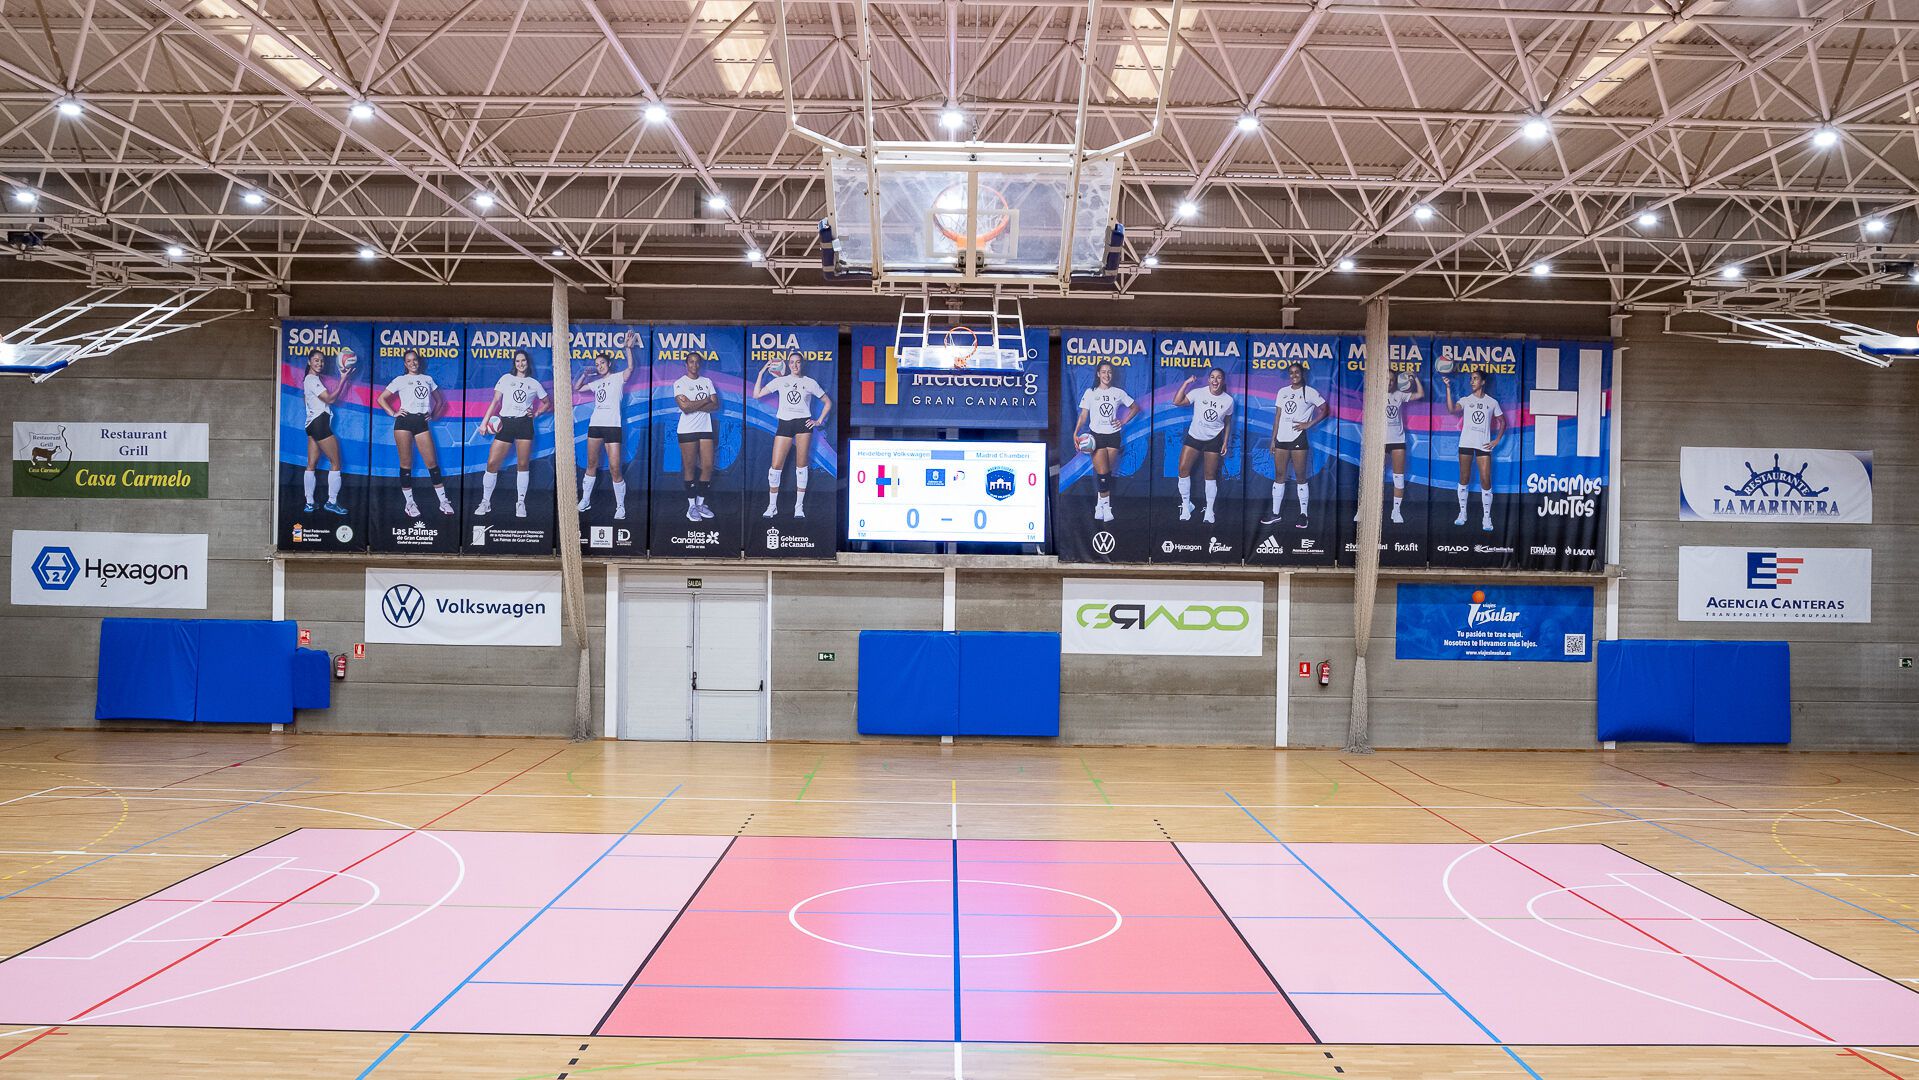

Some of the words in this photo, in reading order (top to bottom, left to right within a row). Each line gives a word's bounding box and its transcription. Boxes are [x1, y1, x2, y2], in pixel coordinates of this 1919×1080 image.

[289, 324, 341, 345] SOFÍA
[380, 329, 460, 347] CANDELA
[658, 333, 706, 349] WIN
[751, 333, 800, 349] LOLA
[1066, 337, 1148, 355] CLAUDIA
[1160, 339, 1240, 357] CAMILA
[1253, 341, 1333, 359] DAYANA
[1348, 343, 1423, 361] MEIA
[569, 349, 625, 360] RANDA
[658, 350, 719, 361] MEDNA
[1442, 345, 1516, 363] BLANCA
[1160, 357, 1212, 368] HIRUELA
[912, 395, 955, 405] GRAN
[965, 396, 1037, 406] CANARIA
[100, 428, 168, 440] Restaurant
[119, 445, 148, 456] Grill
[75, 468, 116, 487] Casa
[121, 469, 191, 487] Carmelo
[857, 470, 866, 484] 0
[1028, 472, 1037, 487] 0
[1743, 472, 1809, 495] RESTAURANTE
[1712, 498, 1737, 515] LA
[1739, 498, 1841, 516] MARINERA
[859, 519, 866, 528] 0
[906, 508, 920, 529] 0
[973, 509, 988, 530] 0
[1028, 521, 1035, 530] 0
[392, 527, 407, 536] Las
[408, 527, 438, 536] Palmas
[687, 530, 706, 538] Islas
[671, 536, 706, 544] Canarias
[1256, 546, 1284, 554] adidas
[436, 598, 546, 618] Volkswagen
[1706, 597, 1769, 609] AGENCIA
[1770, 597, 1845, 610] CANTERAS
[1465, 630, 1486, 639] pasión
[1443, 639, 1471, 647] Nosotros
[1471, 639, 1478, 647] te
[1478, 639, 1507, 647] llevamos
[1521, 640, 1538, 648] lejos.
